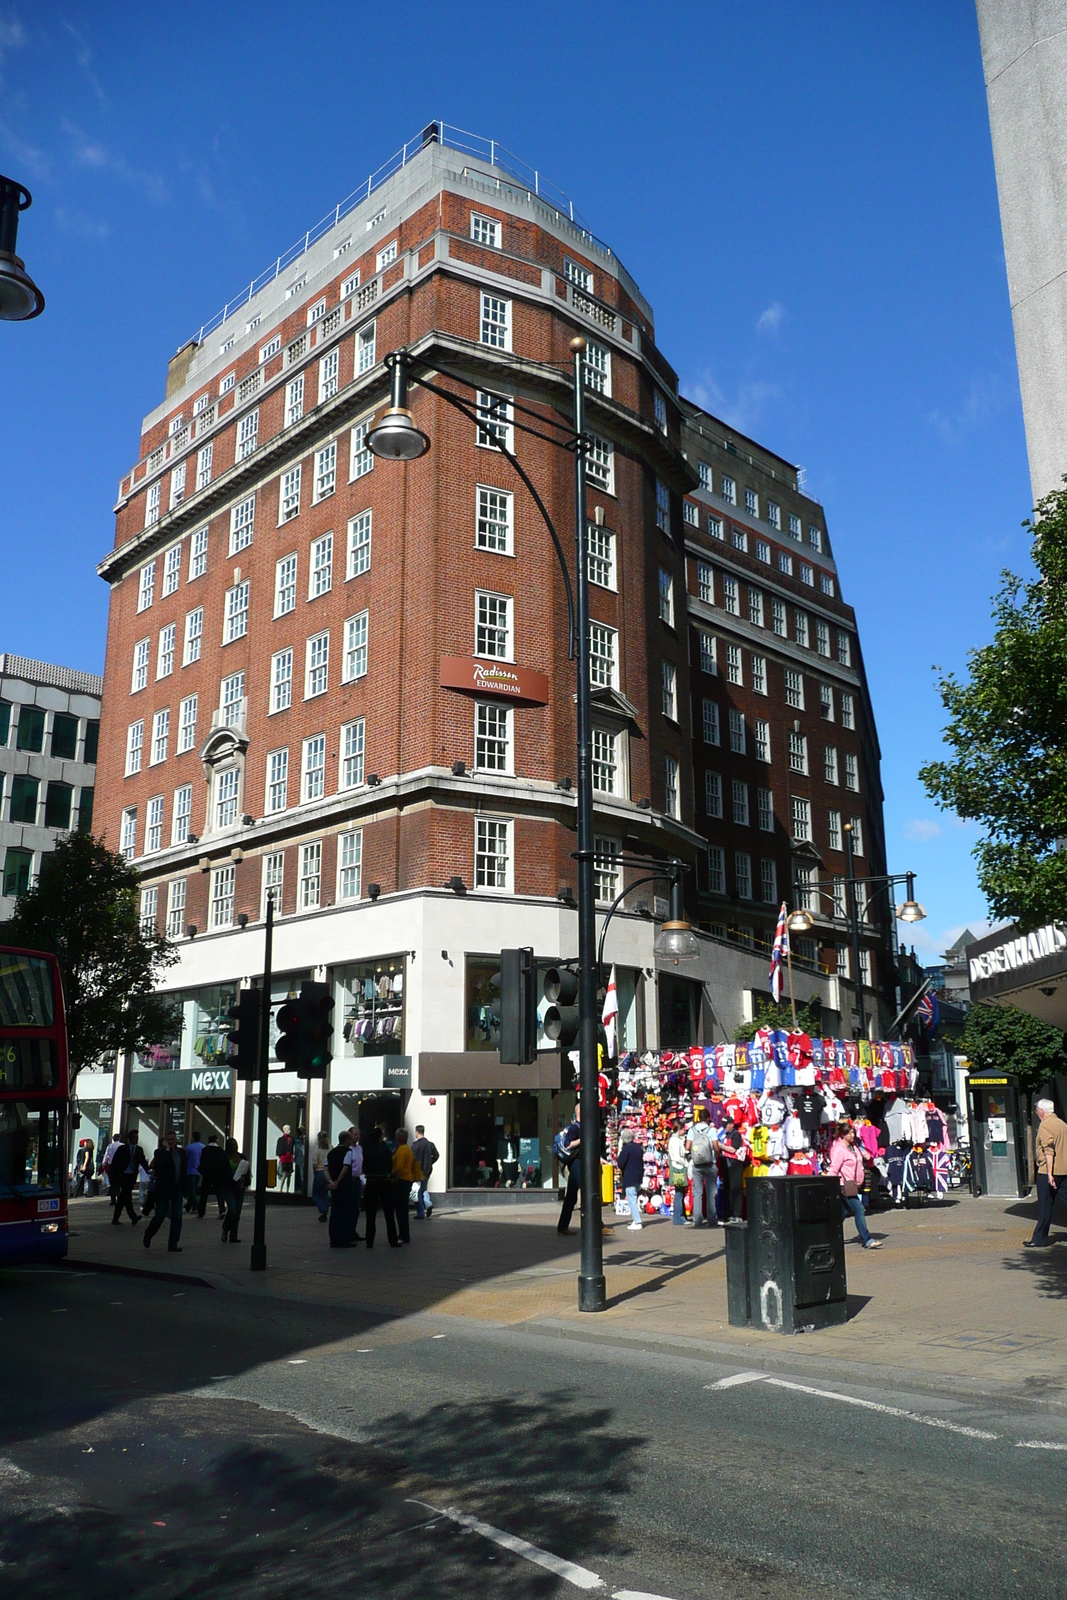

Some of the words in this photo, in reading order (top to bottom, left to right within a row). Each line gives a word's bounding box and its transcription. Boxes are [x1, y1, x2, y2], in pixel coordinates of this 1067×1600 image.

[473, 664, 518, 681] Radisson
[476, 680, 520, 693] EDWARDIAN
[970, 920, 1067, 983] DEBENHAMS
[7, 1046, 16, 1063] 6
[735, 1053, 747, 1069] 14
[751, 1054, 764, 1071] 11
[692, 1059, 702, 1076] 9
[705, 1059, 715, 1076] 8
[765, 1107, 773, 1122] 9
[770, 1140, 777, 1155] 7
